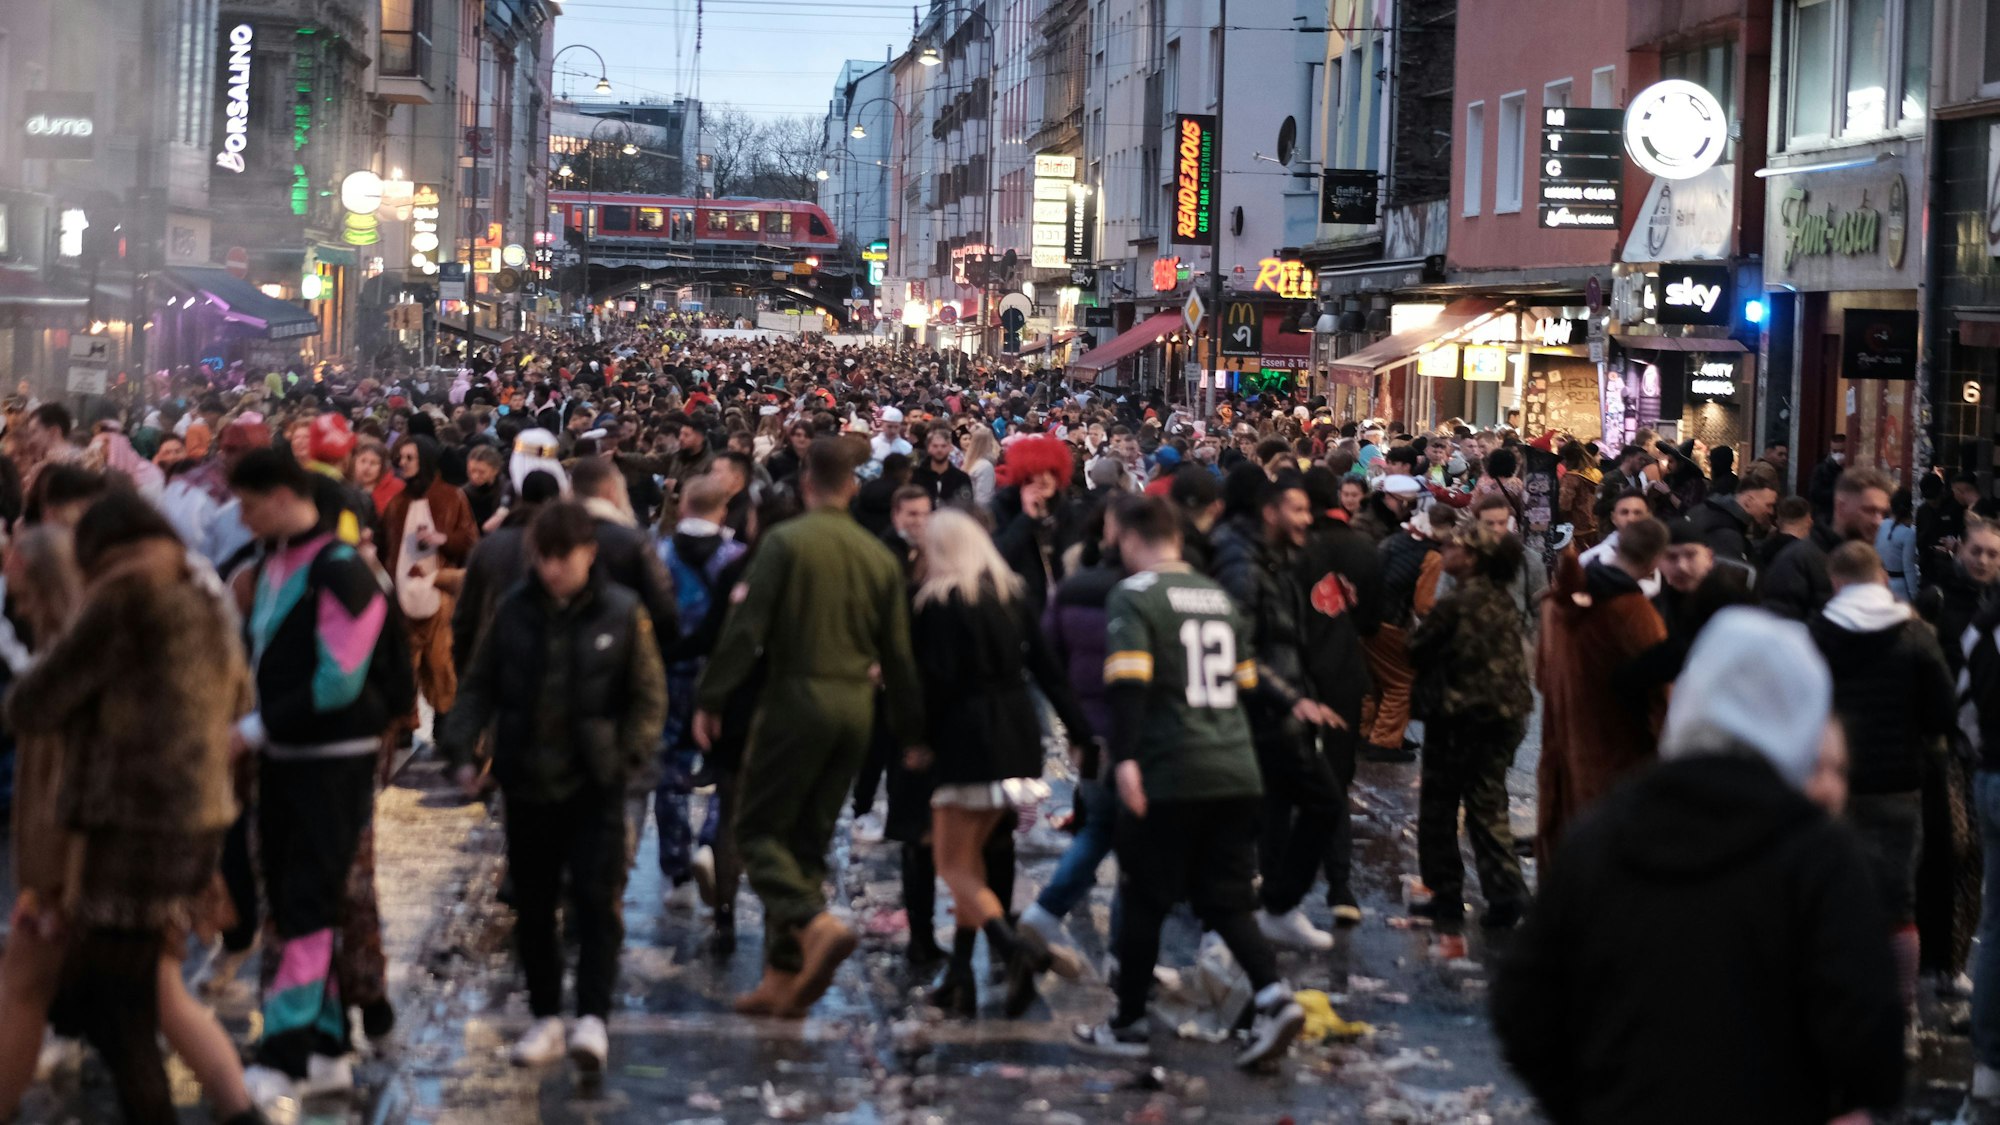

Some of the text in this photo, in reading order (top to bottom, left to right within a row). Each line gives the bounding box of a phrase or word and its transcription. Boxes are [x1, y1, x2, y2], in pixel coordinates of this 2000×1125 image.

[216, 24, 253, 173] BORSALINO
[1546, 109, 1566, 127] M
[1547, 134, 1563, 151] T
[1037, 158, 1073, 174] Falafel
[1177, 119, 1201, 238] RENDEZVOUS
[1545, 160, 1562, 176] C
[1198, 130, 1212, 233] CAFÉ BAR RESTAURANT
[1073, 193, 1085, 256] HILLEBRAN
[1665, 277, 1721, 312] sky
[1260, 358, 1286, 367] Essen
[1288, 358, 1295, 368] &
[1962, 380, 1982, 404] 6
[1179, 618, 1238, 709] 12
